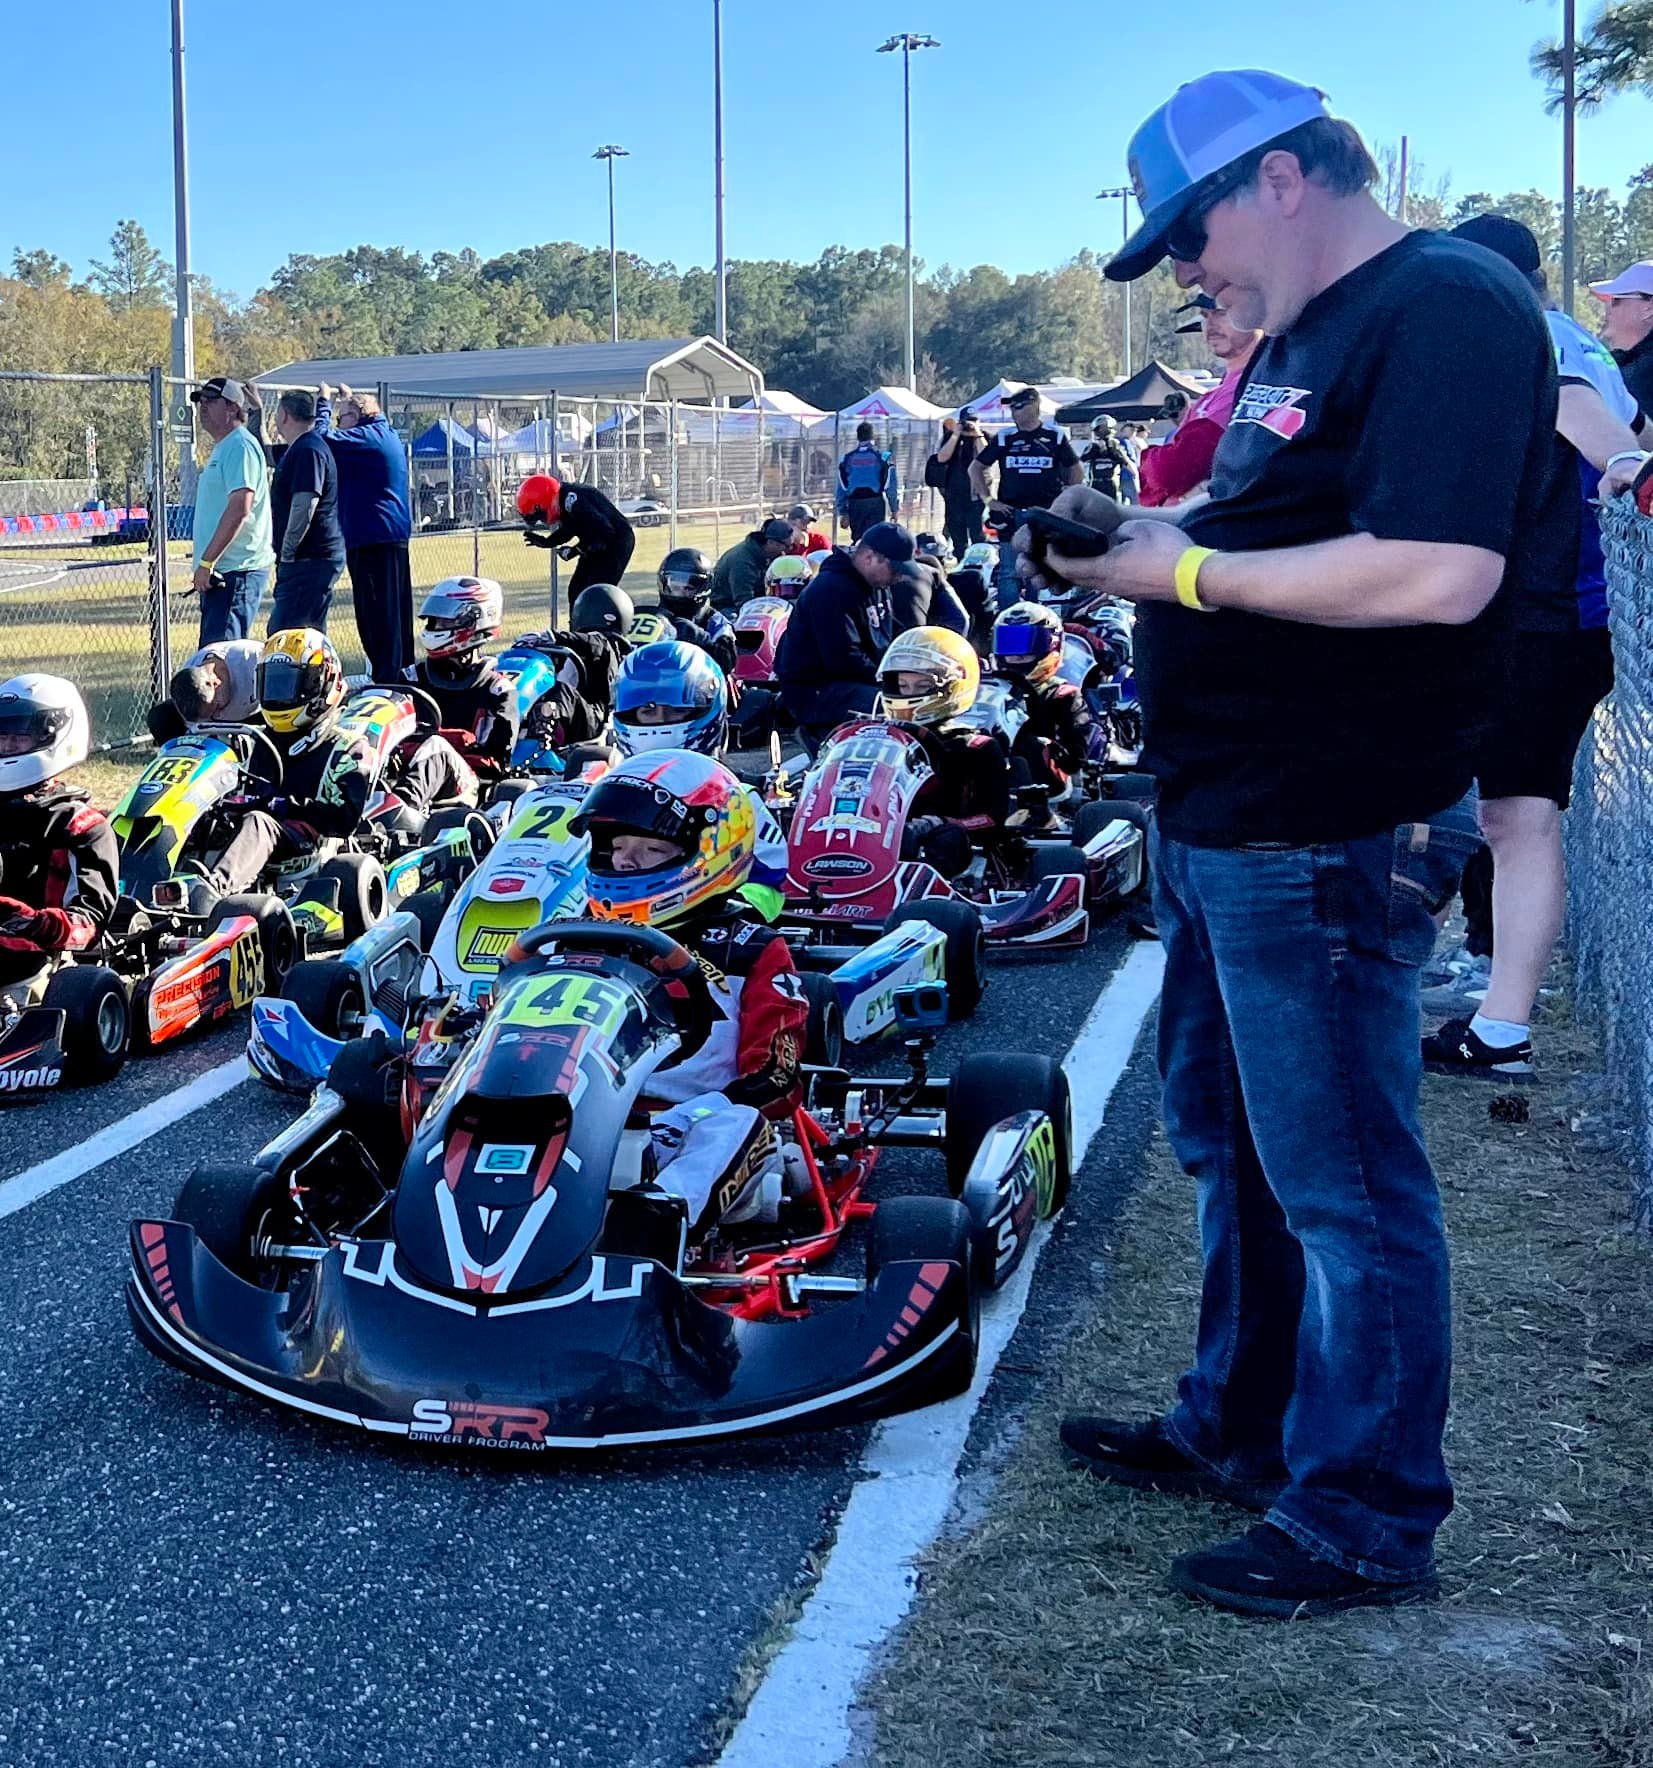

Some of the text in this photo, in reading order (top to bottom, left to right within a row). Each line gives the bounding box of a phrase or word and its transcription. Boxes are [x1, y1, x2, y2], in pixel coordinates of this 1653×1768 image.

[520, 805, 566, 839] 2
[806, 859, 869, 870] LAWSON
[408, 1431, 546, 1451] DRIVER PROGRAM
